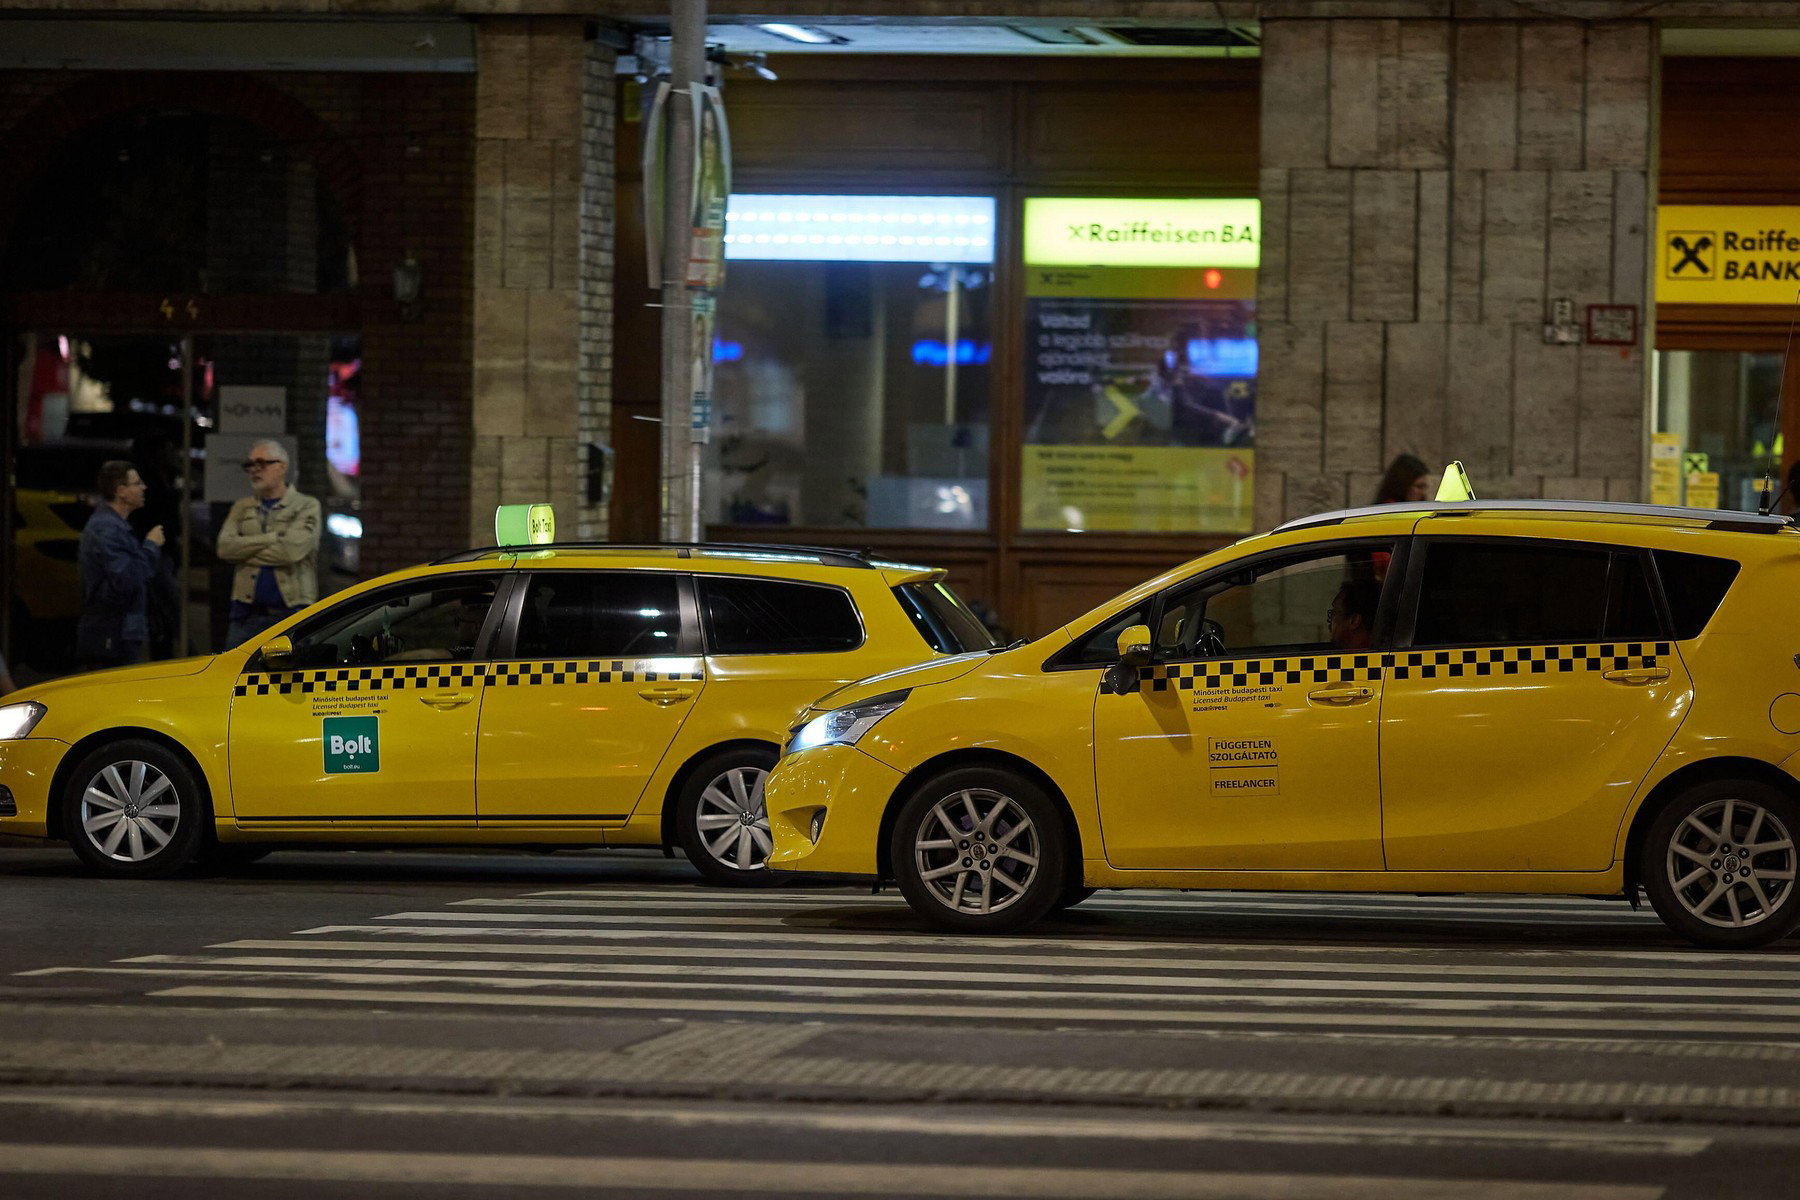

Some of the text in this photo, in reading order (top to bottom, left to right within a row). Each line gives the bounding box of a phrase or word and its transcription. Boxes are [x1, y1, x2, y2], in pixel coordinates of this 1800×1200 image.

[1724, 261, 1800, 280] BANK
[1231, 687, 1267, 695] budapesti
[1193, 696, 1222, 704] Licensed
[1223, 695, 1256, 703] Budapest
[330, 734, 372, 755] Bolt
[1215, 740, 1272, 750] FÜGGETLEN
[1210, 750, 1278, 762] SZOLGÁLTATÓ
[1214, 779, 1276, 789] FREELANCER
